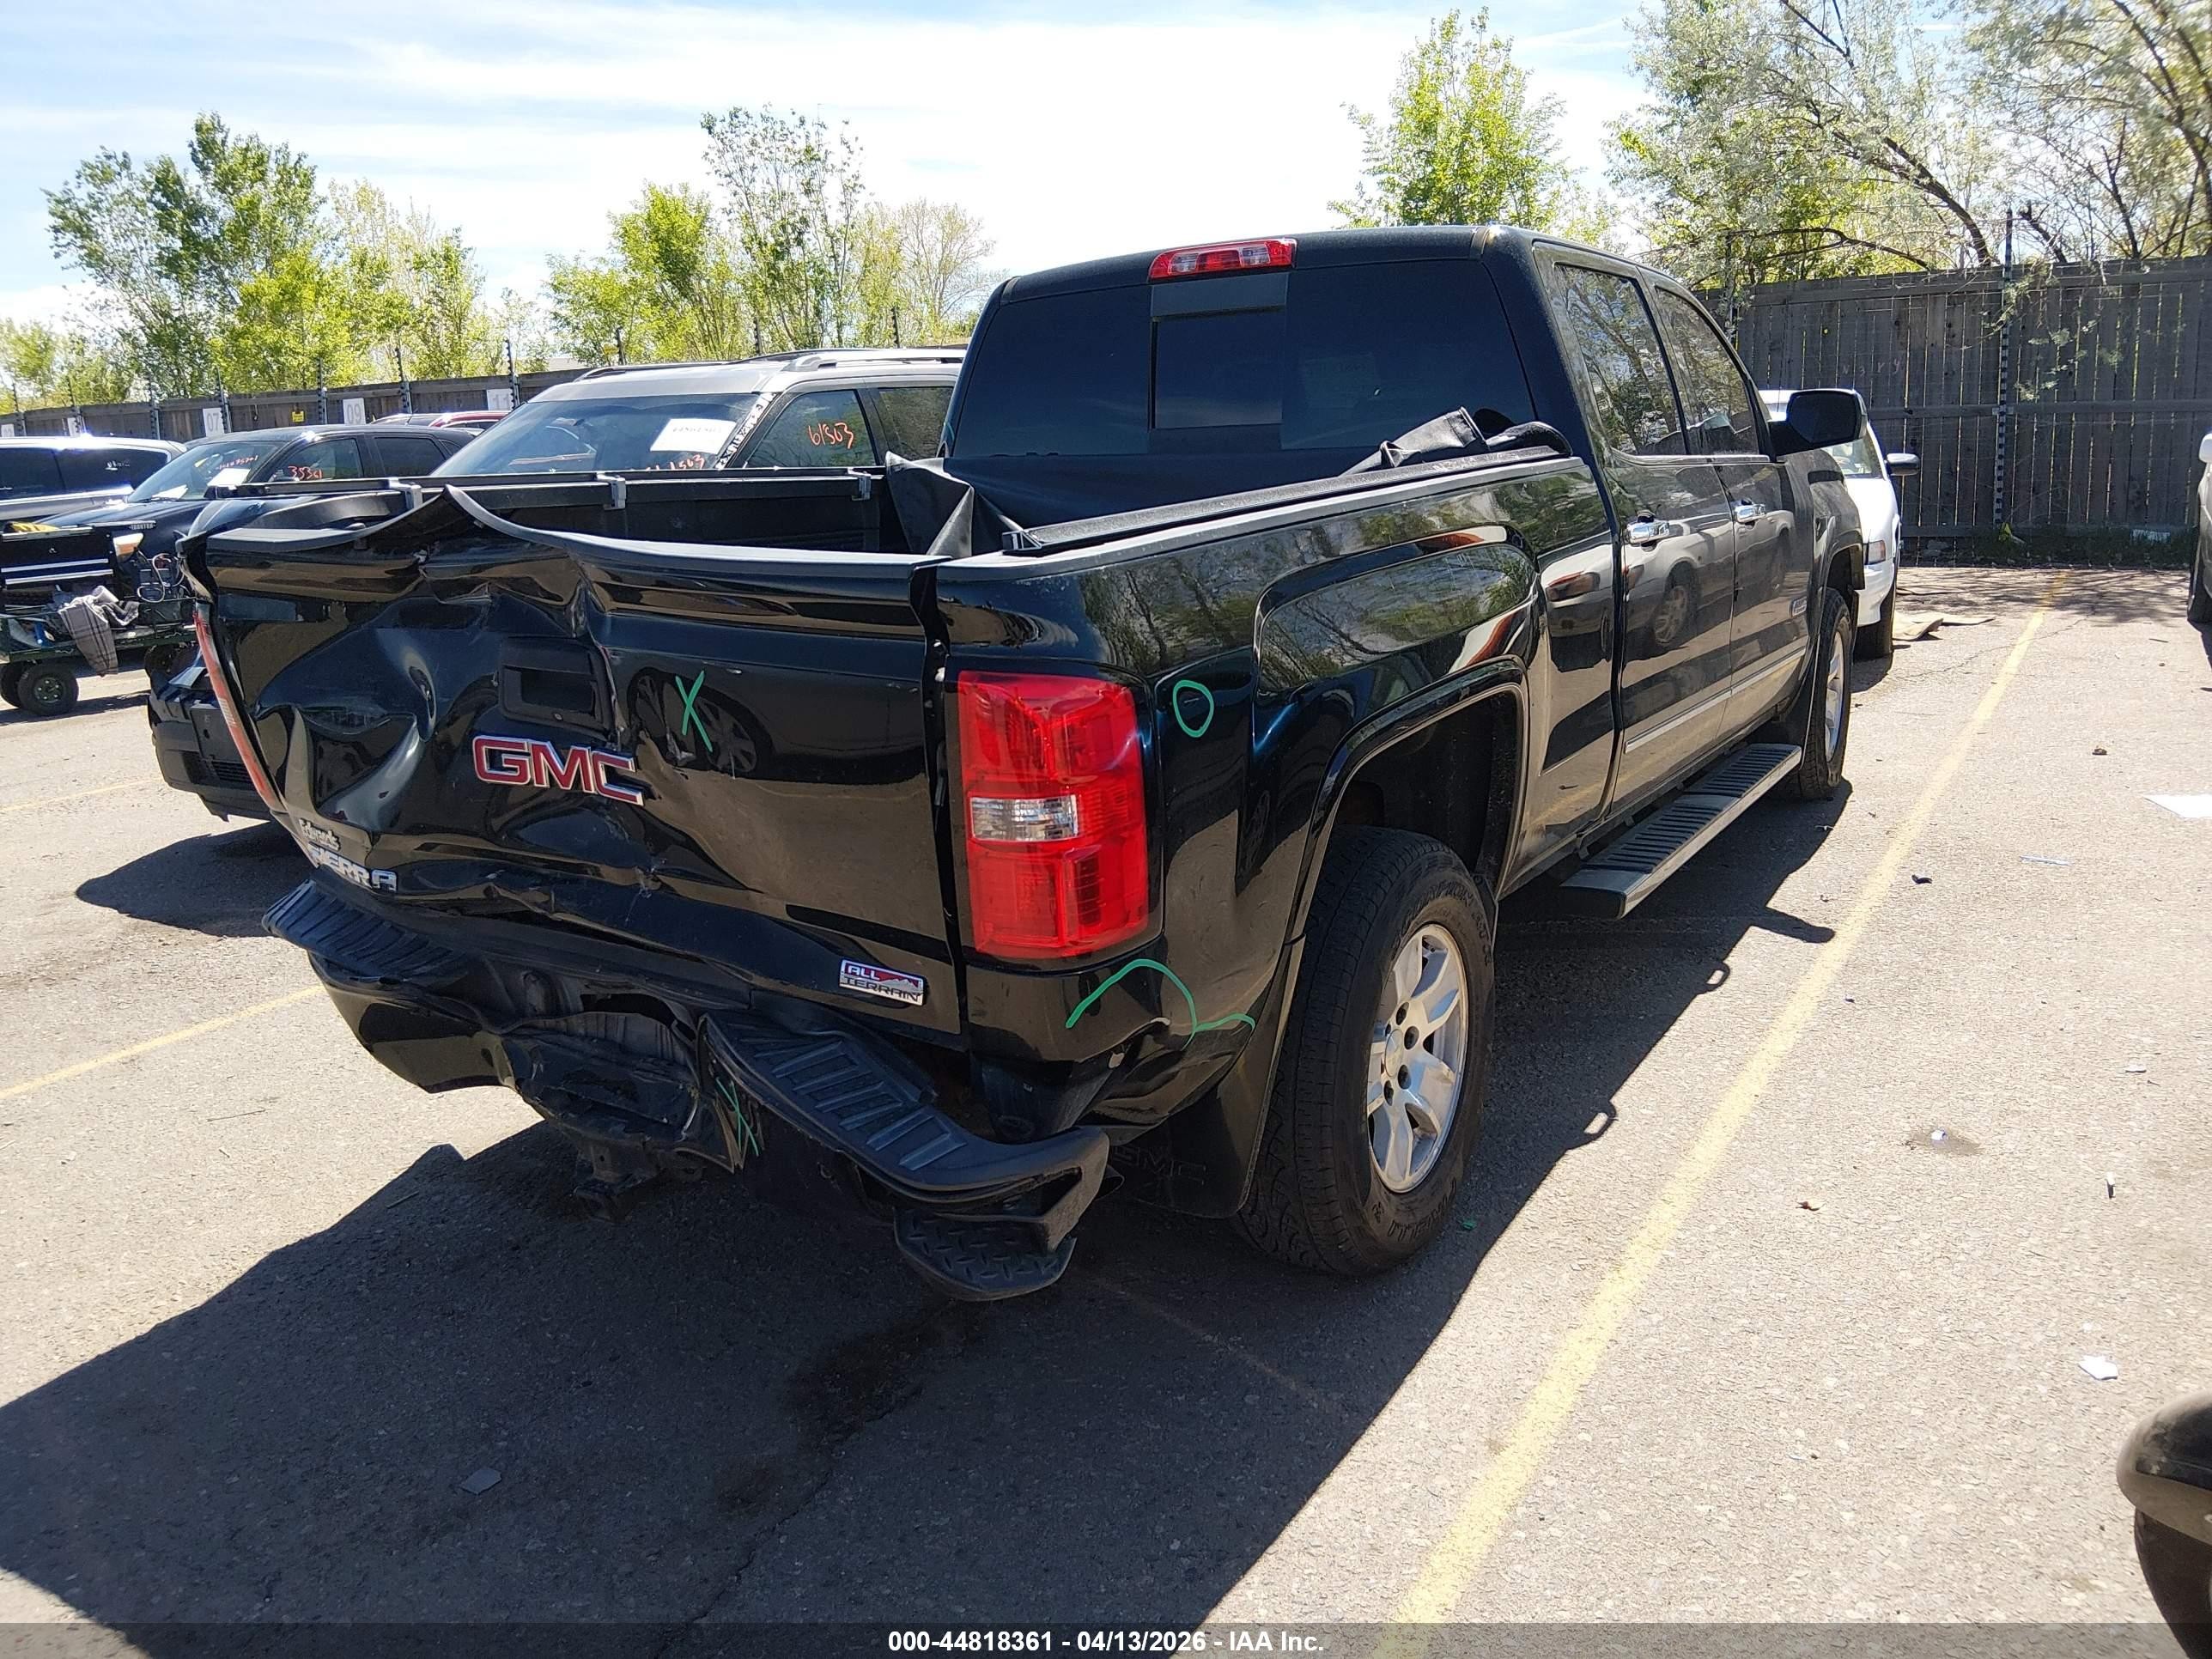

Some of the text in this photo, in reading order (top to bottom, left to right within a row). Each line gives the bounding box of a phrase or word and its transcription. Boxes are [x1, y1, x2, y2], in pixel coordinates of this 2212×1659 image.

[205, 413, 220, 431] 07
[346, 404, 363, 424] 09
[472, 734, 644, 806] GMC
[847, 964, 881, 981] ALL
[839, 976, 925, 1003] TERRAIN
